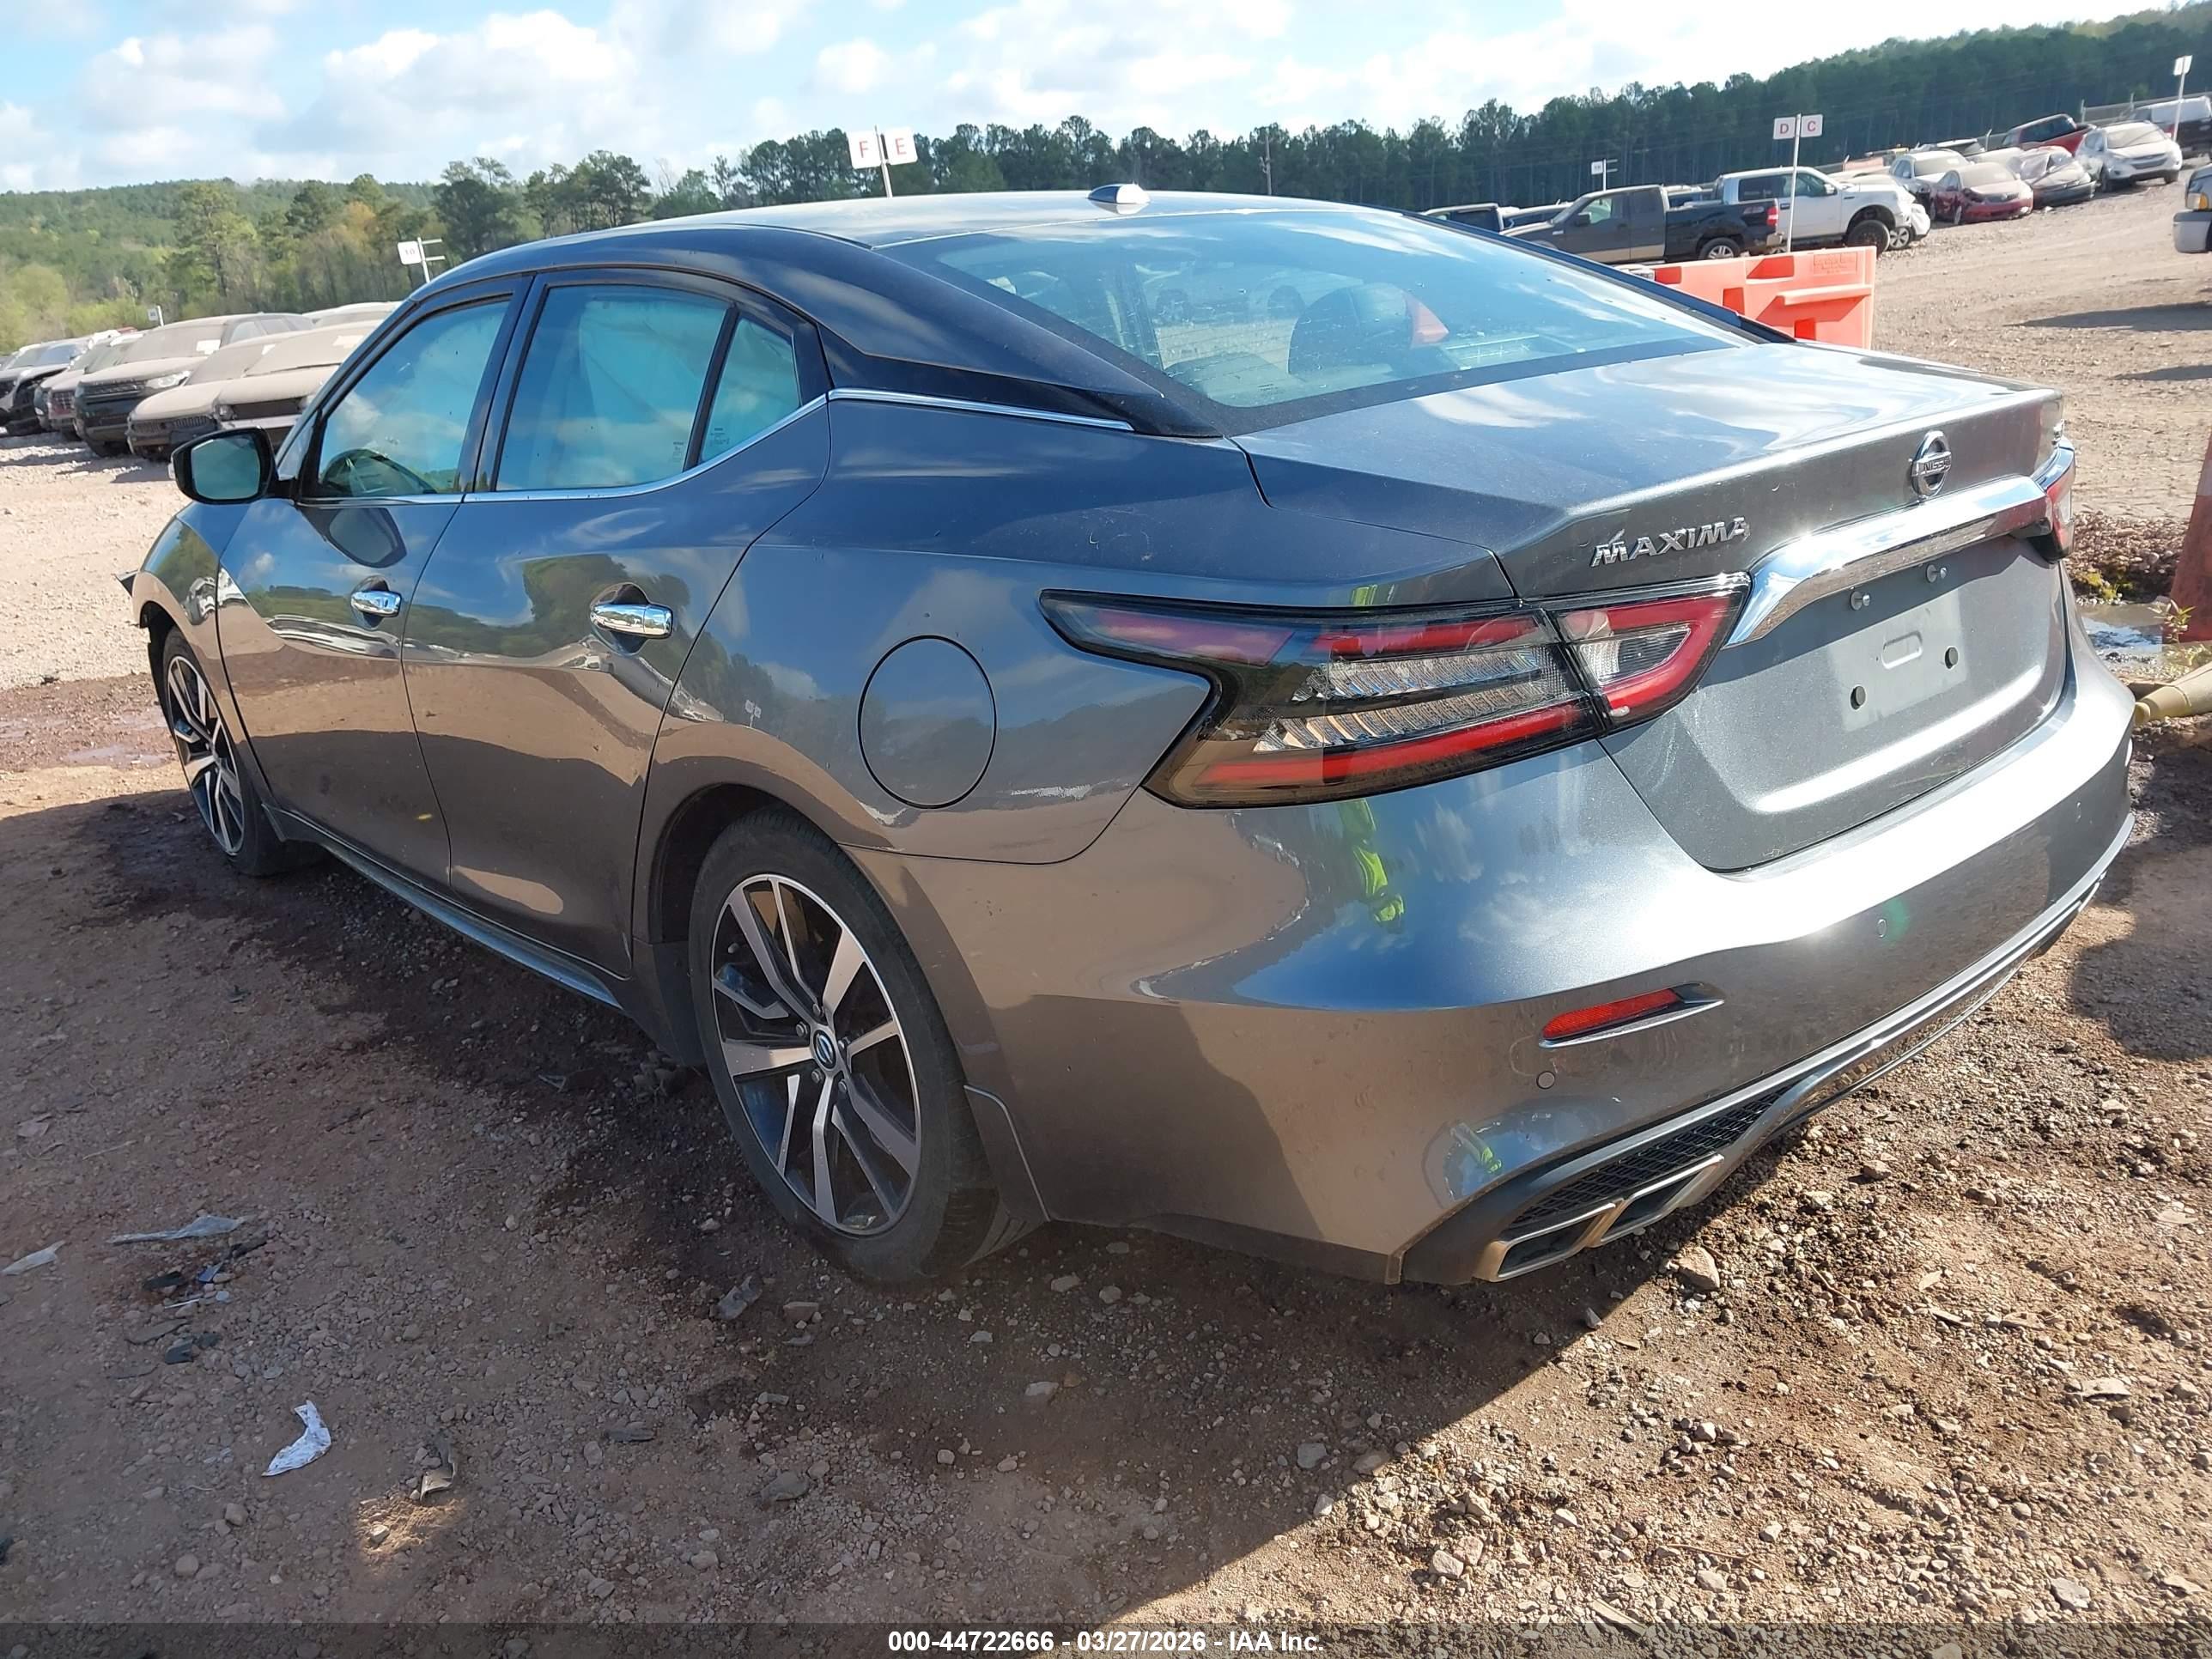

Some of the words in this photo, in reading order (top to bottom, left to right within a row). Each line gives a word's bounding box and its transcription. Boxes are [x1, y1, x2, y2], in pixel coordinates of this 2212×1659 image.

[1779, 123, 1790, 134] D
[1807, 120, 1816, 132] C
[859, 140, 869, 158] F
[895, 137, 907, 155] E
[1590, 516, 1751, 568] MAXIMA
